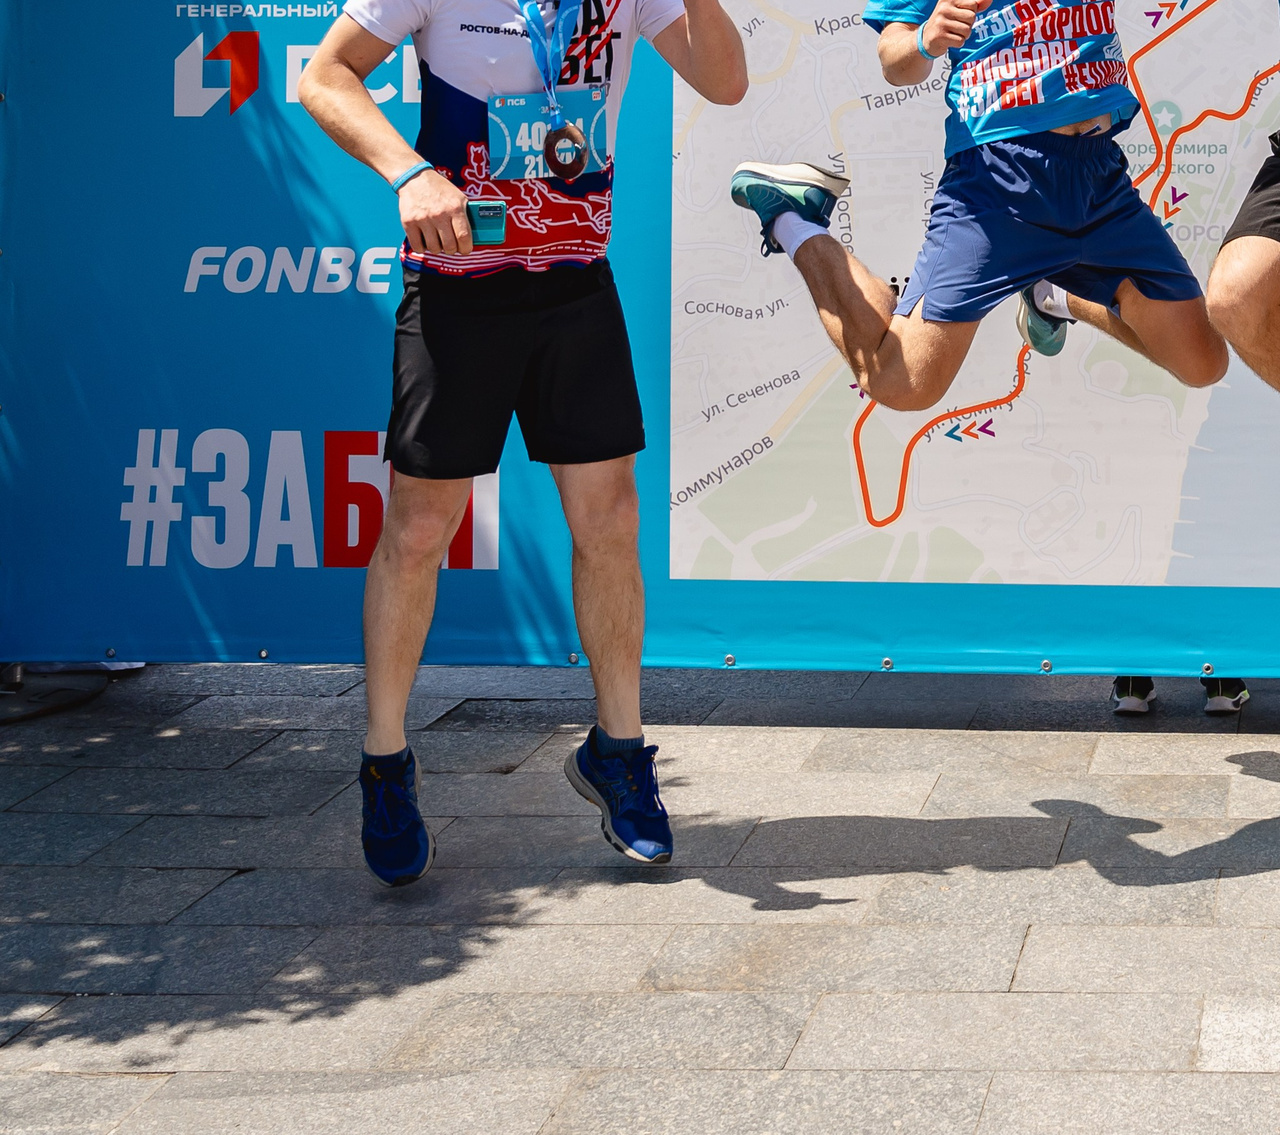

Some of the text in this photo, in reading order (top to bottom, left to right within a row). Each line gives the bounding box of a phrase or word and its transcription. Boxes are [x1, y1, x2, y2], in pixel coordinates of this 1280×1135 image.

[175, 1, 338, 18] ГЕНЕРАЛЬНЫЙ
[742, 16, 765, 37] ул.
[861, 58, 953, 112] Таврическ
[827, 152, 846, 174] ул
[920, 171, 934, 194] ул.
[184, 246, 397, 295] FONBE
[683, 296, 790, 321] Сосновая ул.
[701, 369, 802, 423] ул. Сеченова
[668, 433, 775, 511] Коммунаров
